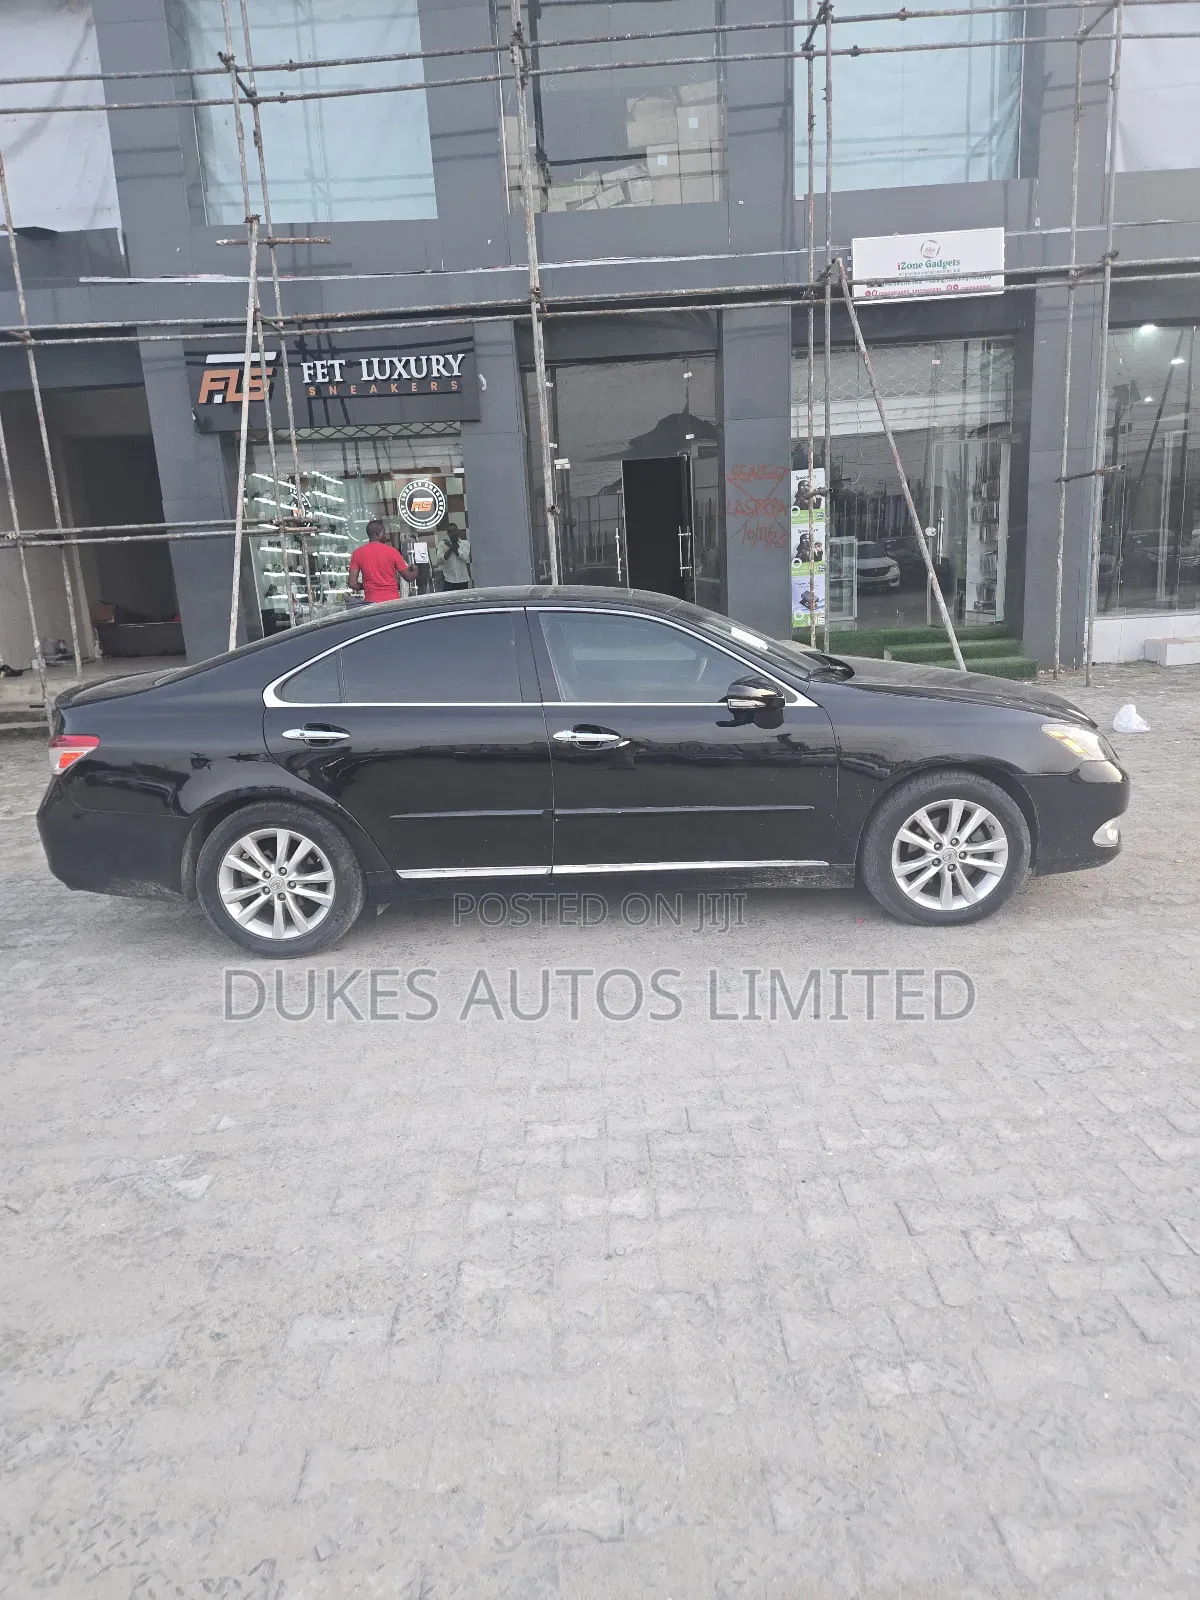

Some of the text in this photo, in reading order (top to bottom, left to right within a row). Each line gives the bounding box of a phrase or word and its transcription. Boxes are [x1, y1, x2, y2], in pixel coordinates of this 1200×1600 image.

[897, 259, 961, 271] iZone Gadgets
[300, 353, 466, 384] FET LUXURY
[308, 380, 459, 397] SNEAKERS
